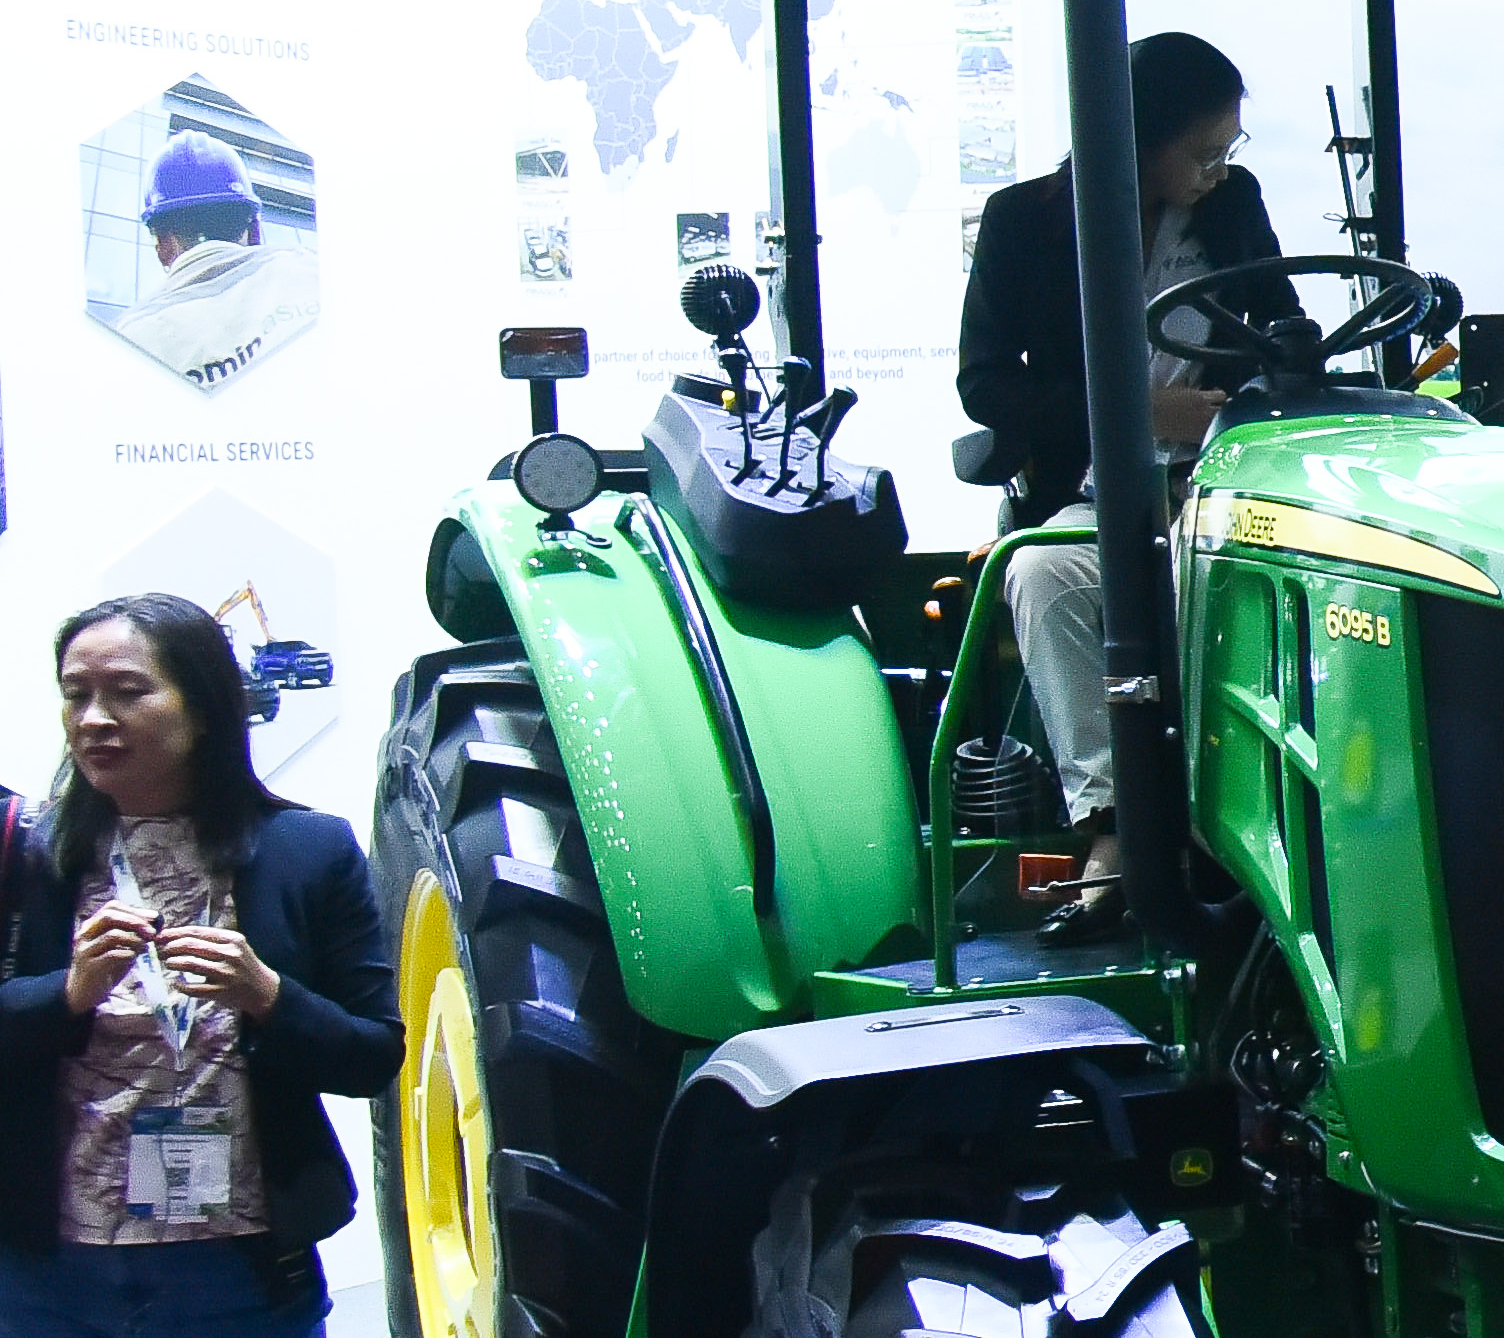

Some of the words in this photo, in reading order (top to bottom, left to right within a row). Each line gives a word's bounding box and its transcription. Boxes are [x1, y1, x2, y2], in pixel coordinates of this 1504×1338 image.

[66, 19, 199, 52] ENGINEERING
[204, 34, 311, 61] SOLUTIONS
[594, 348, 640, 364] partner
[642, 348, 654, 362] of
[658, 347, 698, 362] choice
[853, 346, 926, 362] equipment,
[829, 367, 852, 380] and
[856, 367, 904, 381] beyond
[115, 442, 221, 464] FINANCIAL
[226, 440, 315, 463] SERVICES
[1244, 508, 1277, 542] DEERE
[1325, 602, 1374, 643] 6095
[1376, 615, 1391, 647] B
